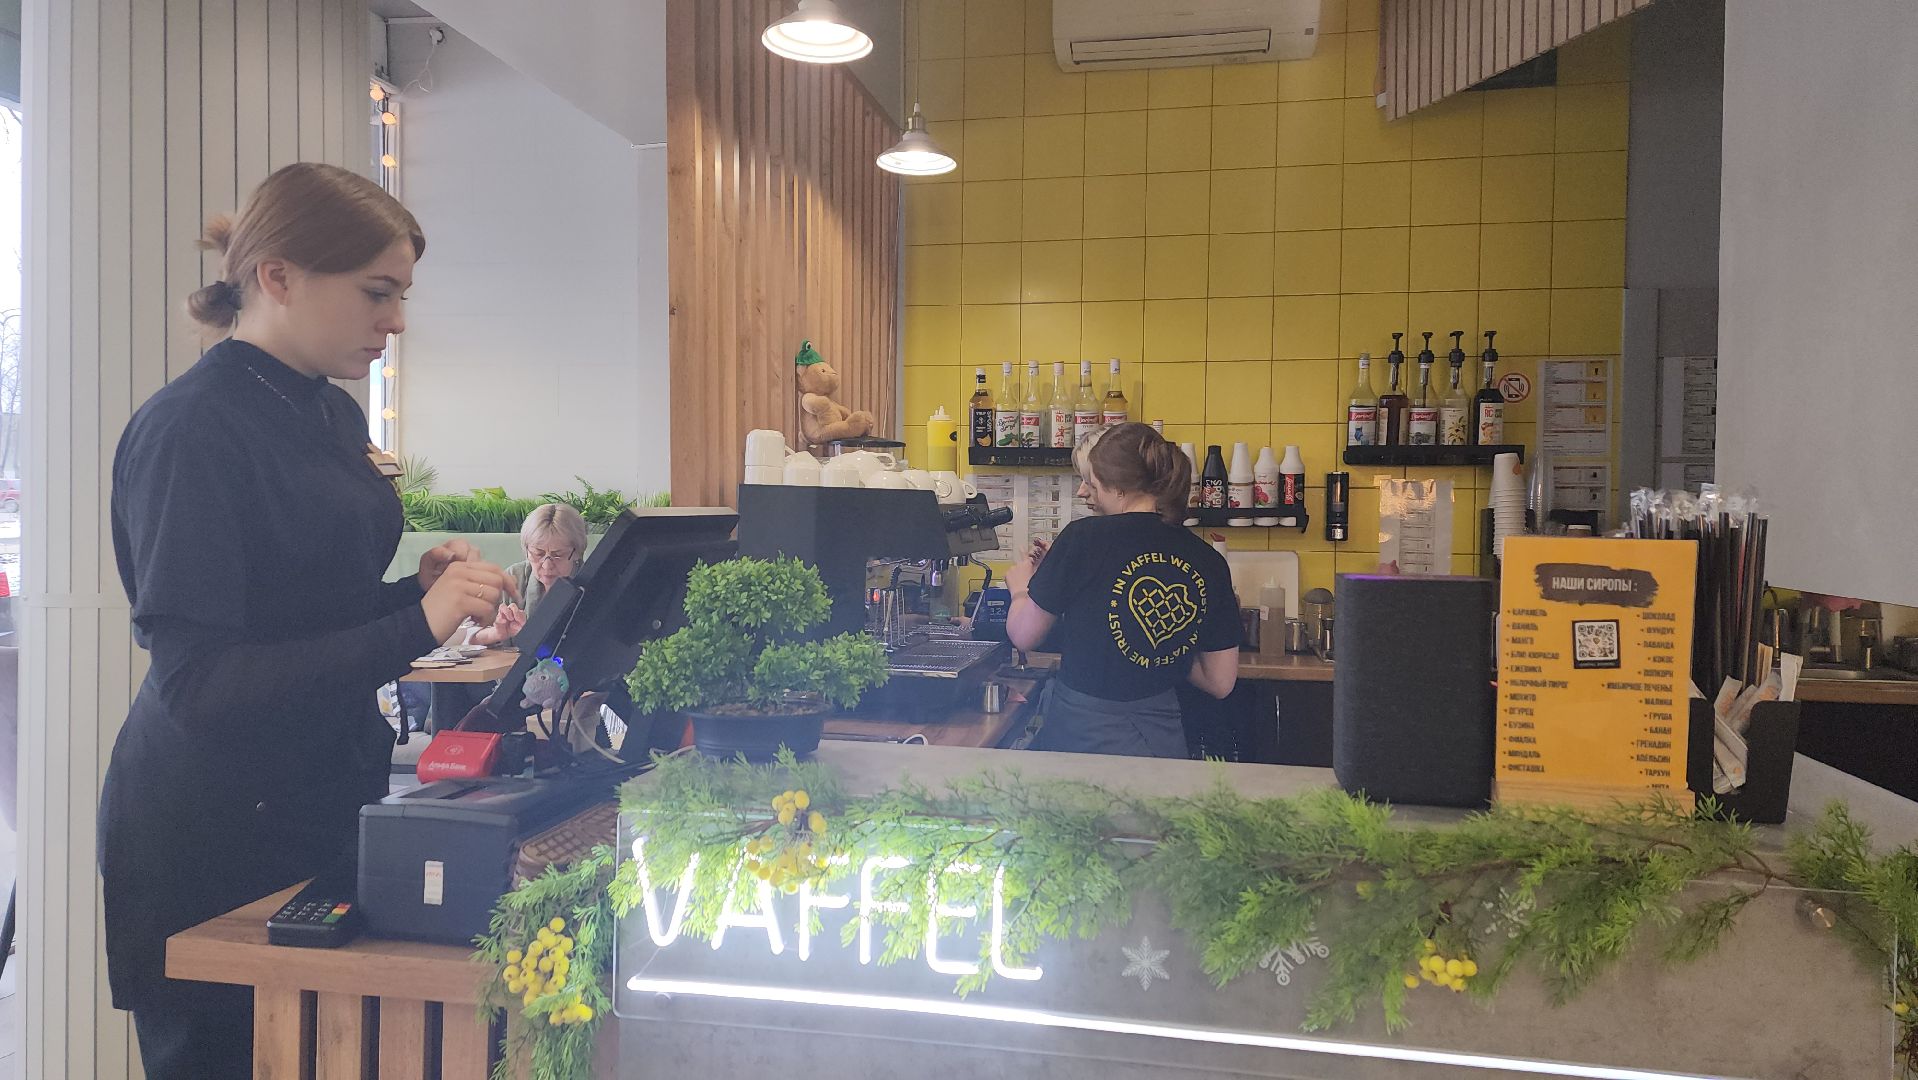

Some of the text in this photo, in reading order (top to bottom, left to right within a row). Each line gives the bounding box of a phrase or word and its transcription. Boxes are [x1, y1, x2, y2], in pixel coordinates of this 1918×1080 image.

[1112, 552, 1208, 614] IN VAFFEL WE TRUST
[1552, 576, 1585, 590] НАШИ
[1108, 612, 1131, 656] TRUST
[1129, 651, 1150, 669] WE
[1649, 712, 1673, 721] ГРУША
[1649, 727, 1672, 735] БАНАН
[1636, 739, 1672, 749] ГРЕНАДИН
[1644, 768, 1671, 777] ТАРХУН
[631, 835, 1044, 981] VAFFEL
